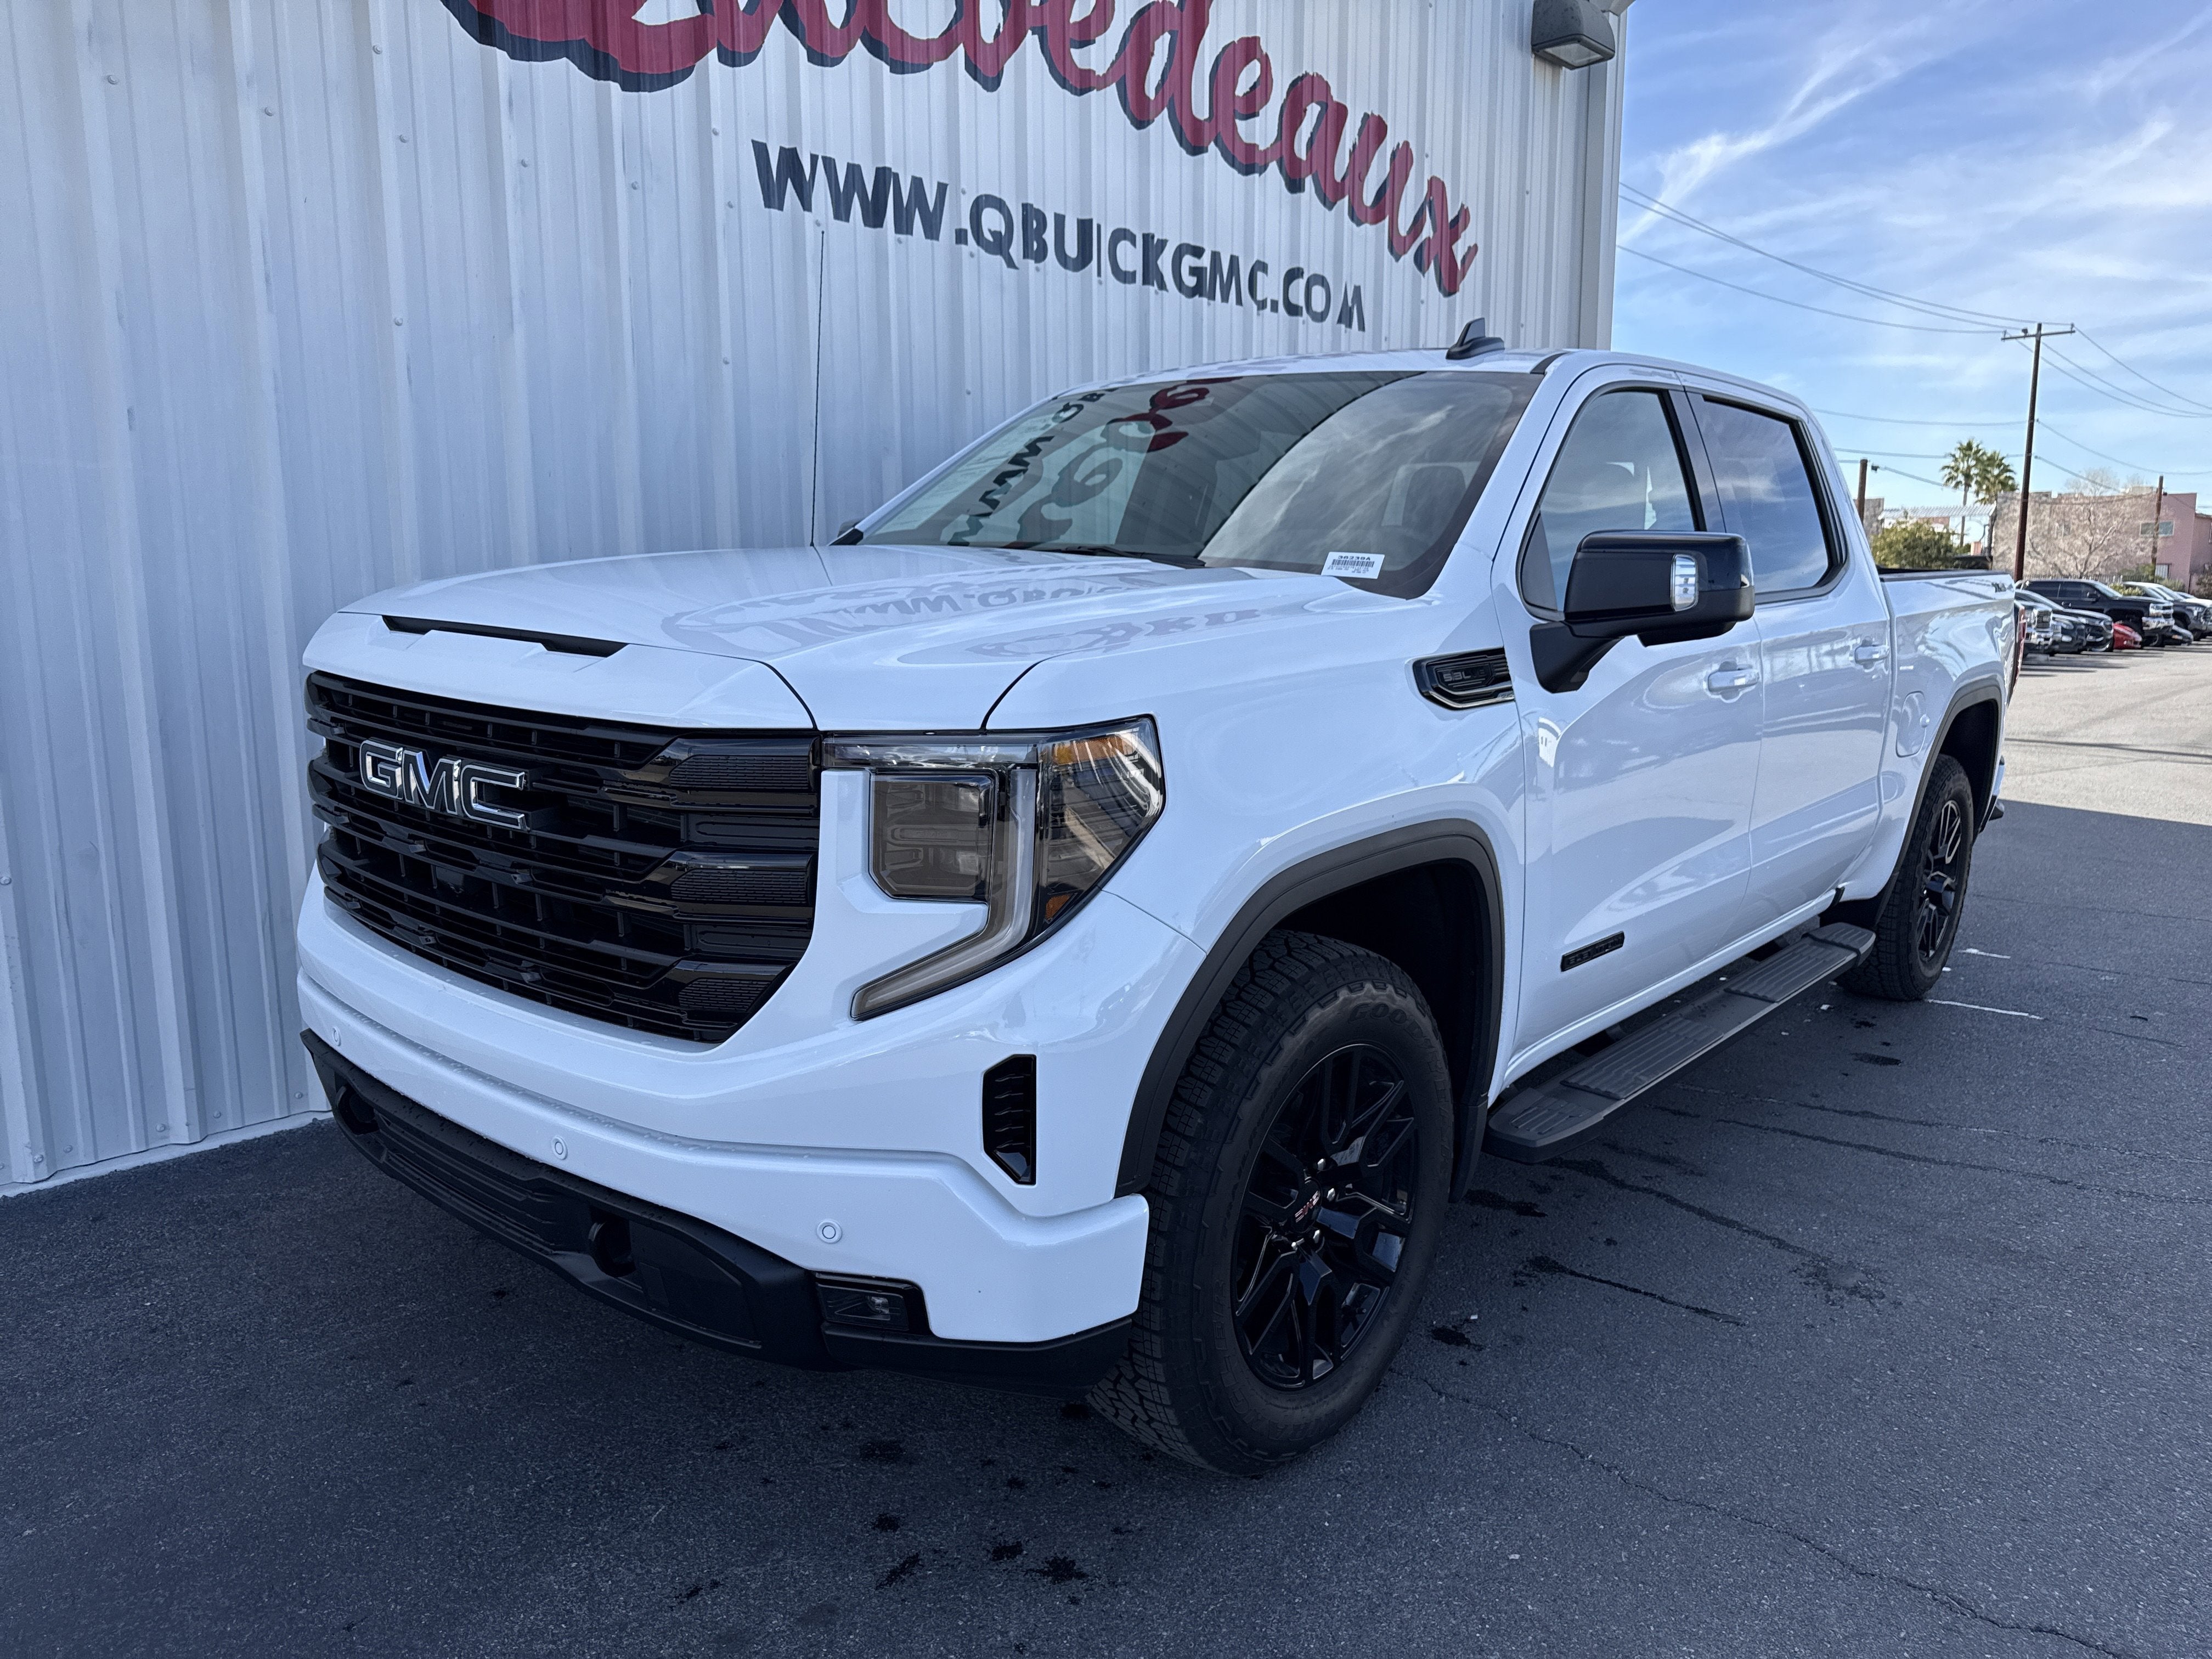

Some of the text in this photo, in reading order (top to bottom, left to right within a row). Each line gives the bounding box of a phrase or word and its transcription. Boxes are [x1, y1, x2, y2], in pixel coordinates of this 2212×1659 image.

[752, 139, 1365, 332] WWW.QBUICKGMC.COM
[359, 739, 526, 830] GMC
[1291, 1190, 1321, 1223] GMC
